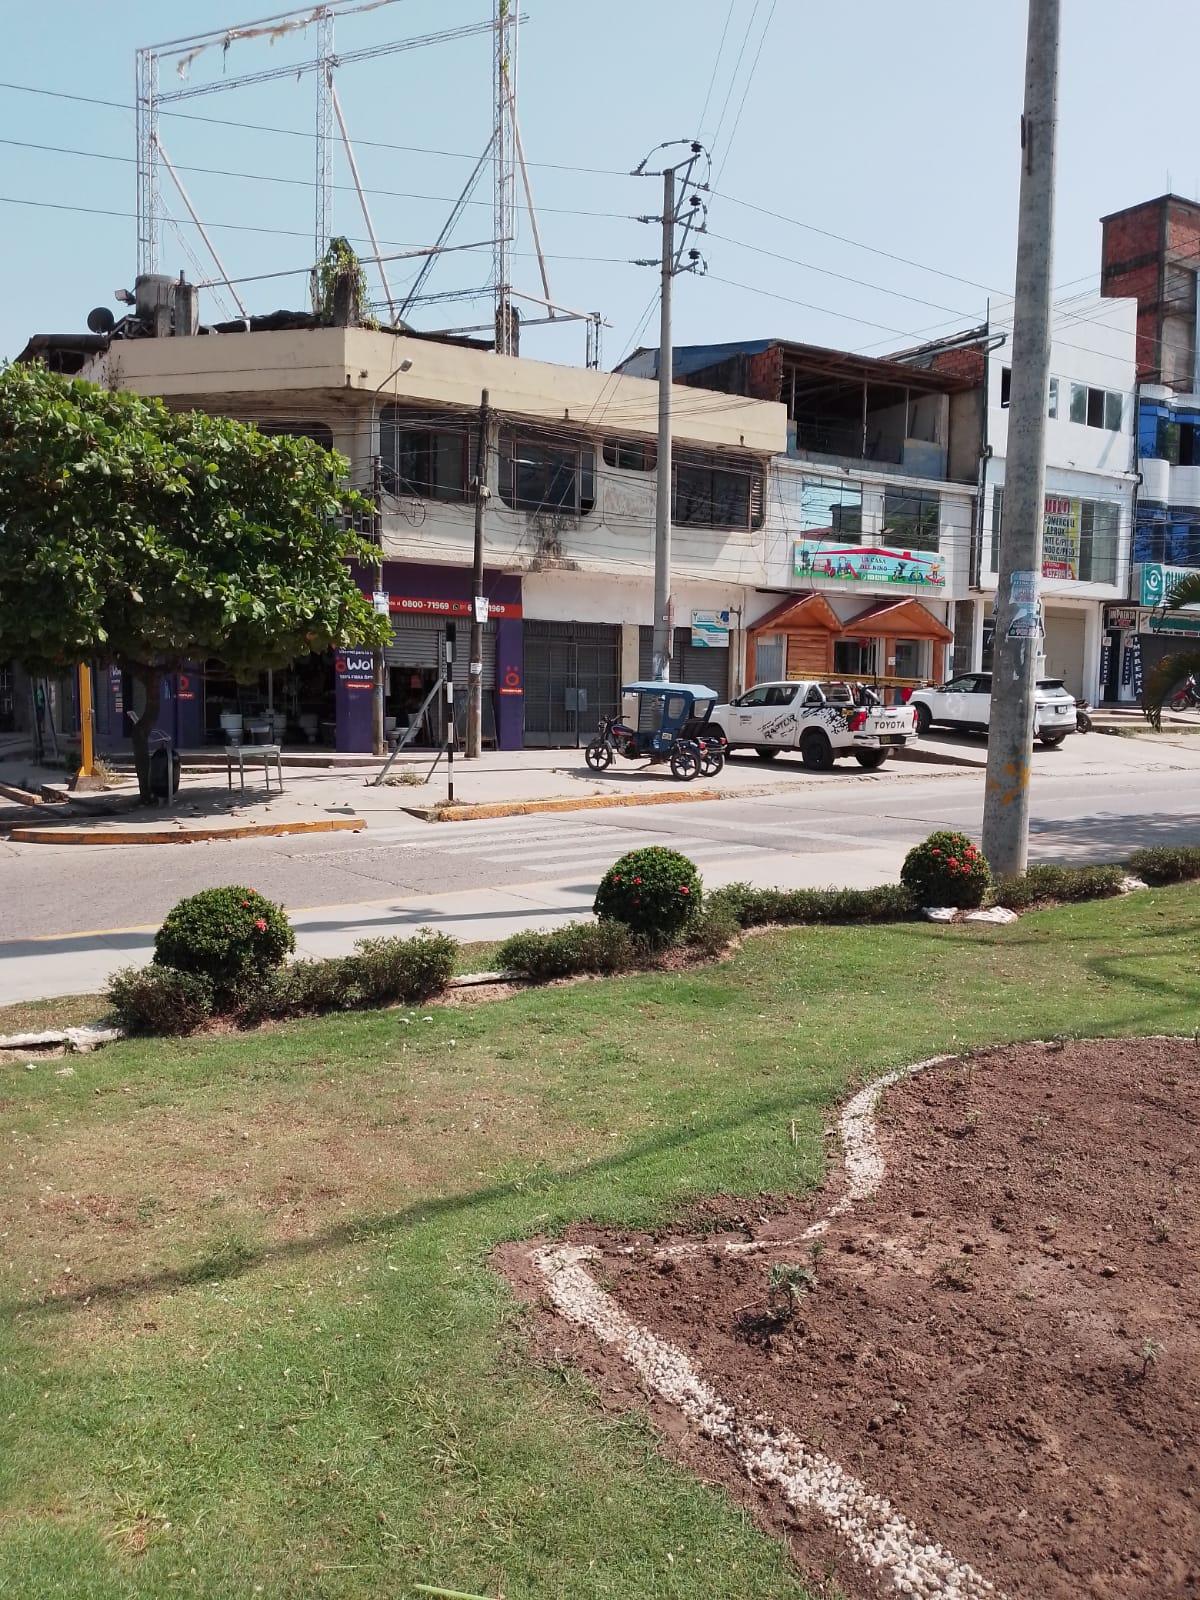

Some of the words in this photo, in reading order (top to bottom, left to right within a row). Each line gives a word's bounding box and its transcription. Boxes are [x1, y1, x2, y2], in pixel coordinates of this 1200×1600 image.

[402, 601, 449, 610] 0800-71969
[1133, 636, 1143, 694] IMPRENTA
[874, 721, 905, 729] TOYOTA
